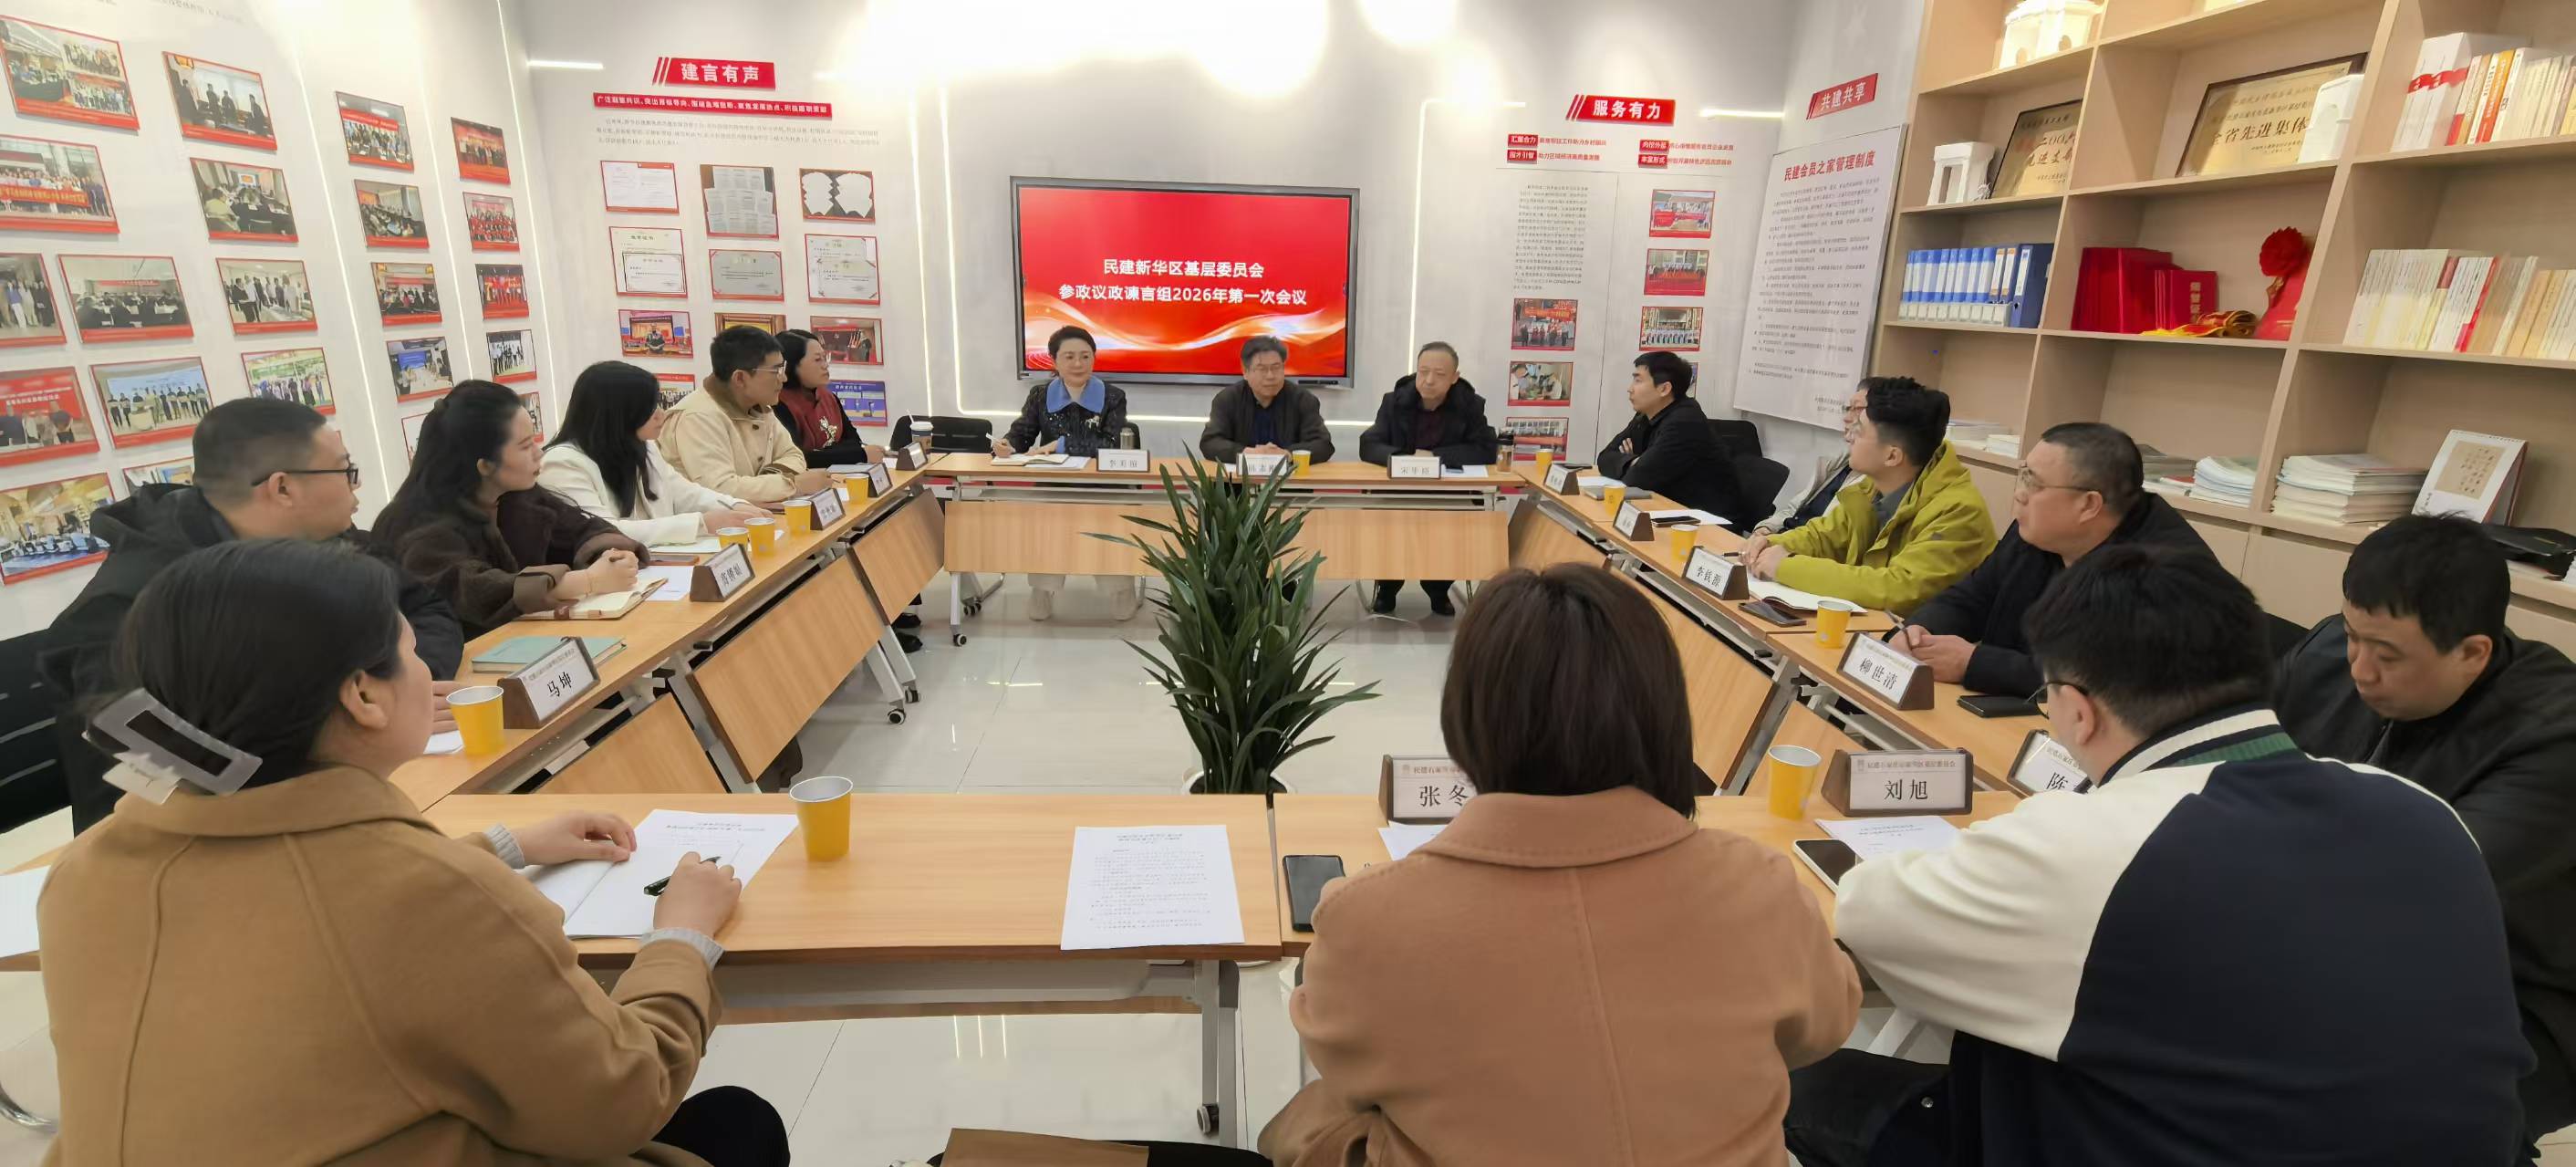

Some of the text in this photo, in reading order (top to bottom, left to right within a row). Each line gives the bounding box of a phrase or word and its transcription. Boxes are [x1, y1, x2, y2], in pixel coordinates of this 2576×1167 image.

[680, 62, 759, 84] 建言有声
[1821, 81, 1866, 111] 共建共享
[1592, 99, 1662, 120] 服务有力
[1783, 150, 1876, 182] 民建会员之家管理制度
[1103, 258, 1264, 279] 民建新华区基层委员会
[1058, 283, 1307, 306] 参政议政谏言组2026年第一次会议
[546, 671, 573, 697] 马坤
[1884, 777, 1929, 801] 刘旭
[2046, 771, 2069, 791] 陈
